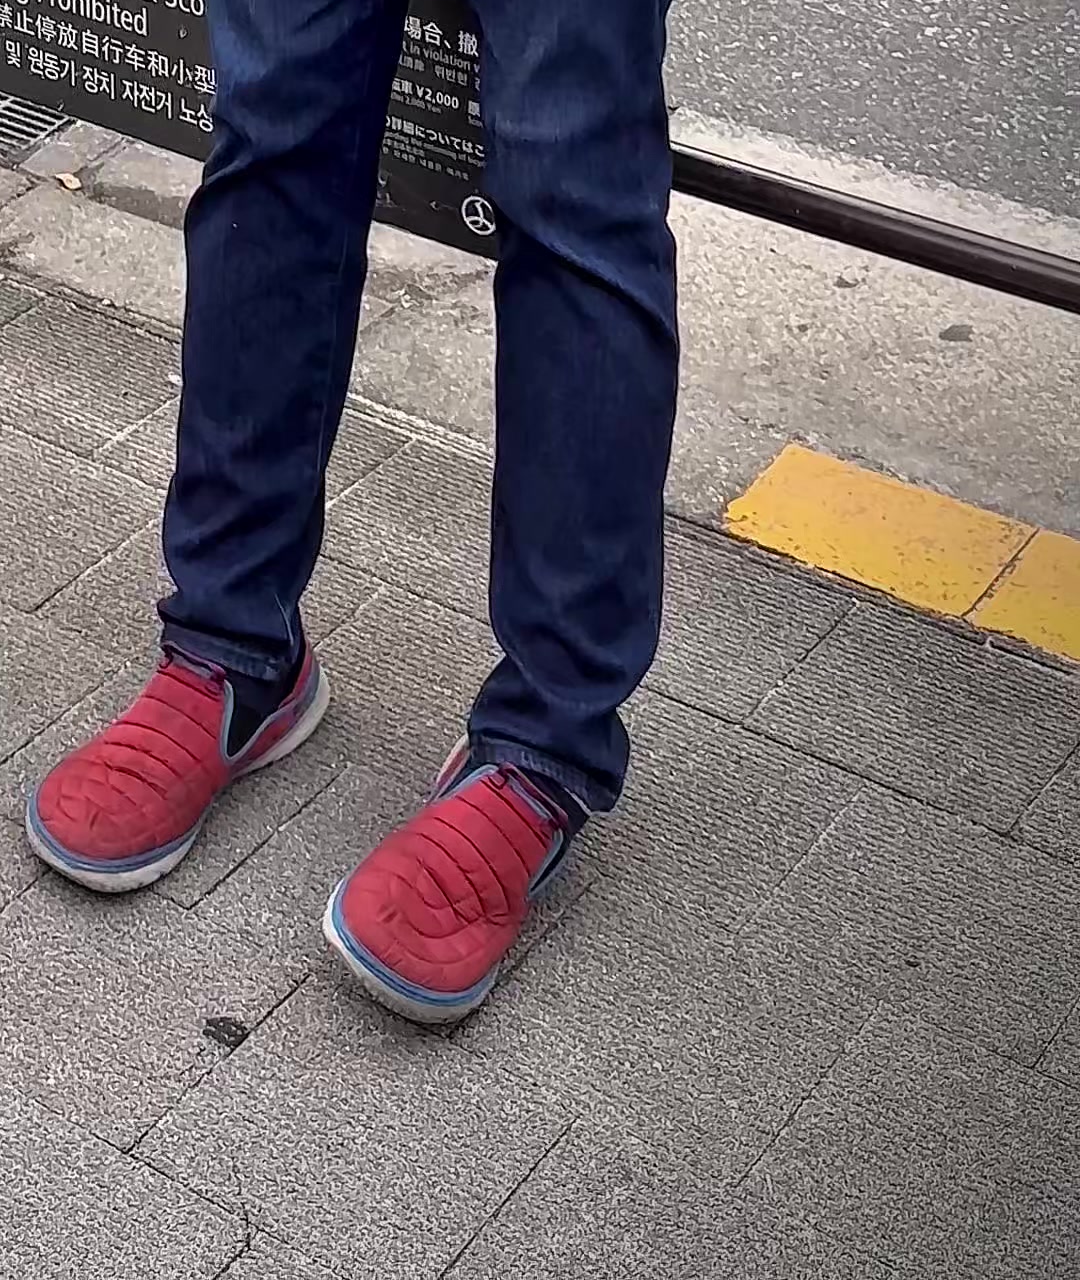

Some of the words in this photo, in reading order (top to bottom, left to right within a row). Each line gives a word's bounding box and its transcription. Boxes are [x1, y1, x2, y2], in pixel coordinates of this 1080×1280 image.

[5, 40, 21, 68] 및
[27, 46, 76, 87] 원동기
[82, 65, 115, 100] 장치
[121, 80, 172, 120] 자전거
[423, 47, 471, 71] violation
